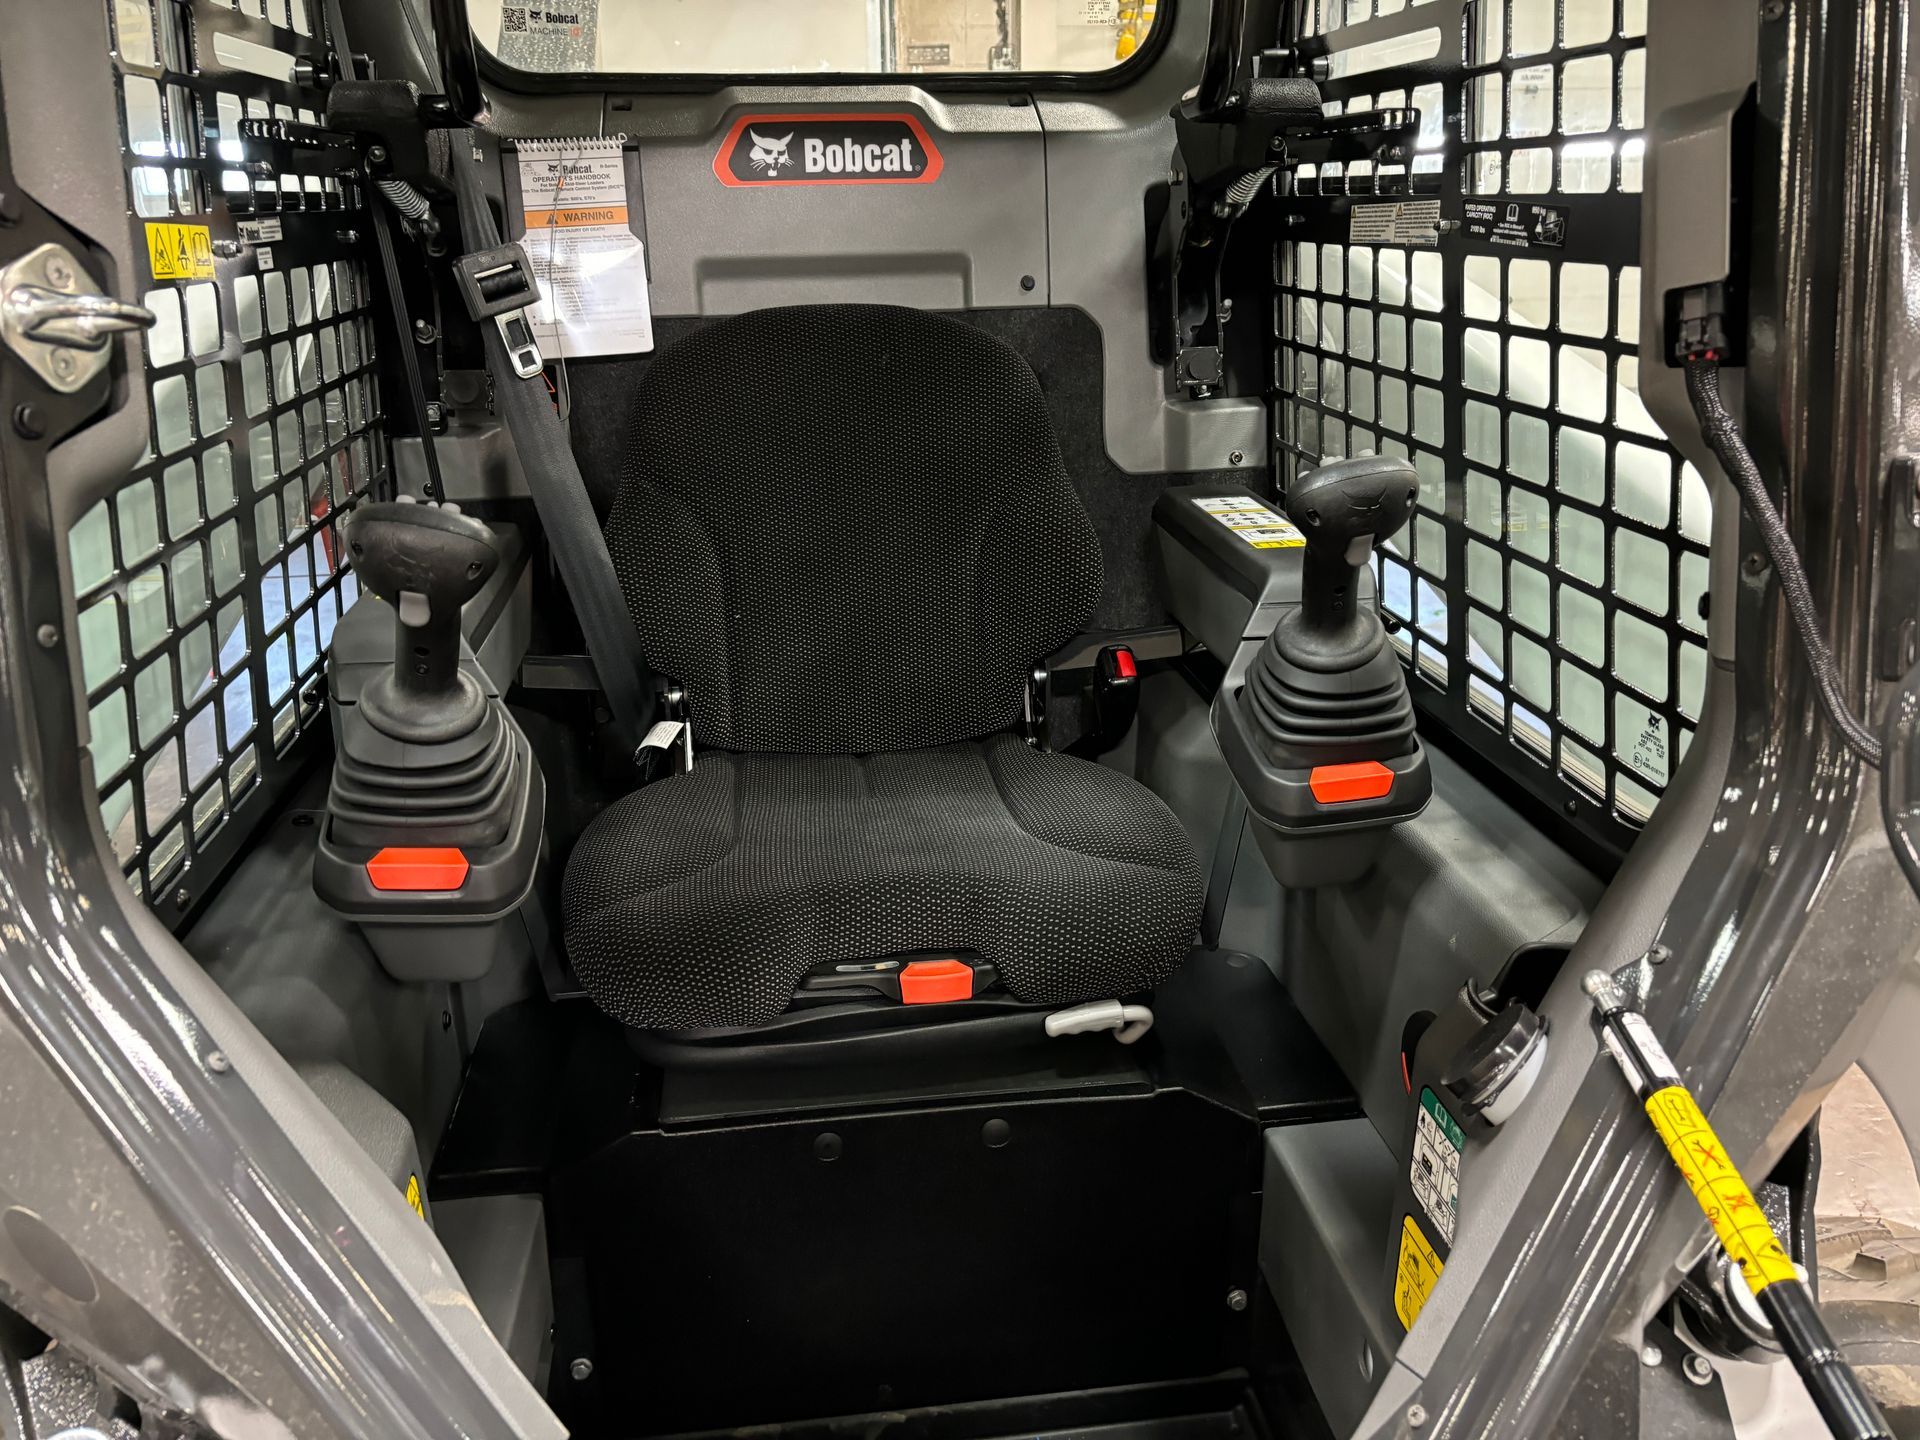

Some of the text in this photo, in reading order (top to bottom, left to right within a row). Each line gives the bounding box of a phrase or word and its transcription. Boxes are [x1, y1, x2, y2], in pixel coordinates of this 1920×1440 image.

[545, 12, 579, 24] Bobcat
[529, 27, 568, 36] MACHINE
[803, 137, 913, 173] Bobcat
[562, 164, 592, 174] Bobcat
[532, 173, 611, 183] OPERATR'S HANDBOOK
[1476, 205, 1496, 213] OPERATING
[563, 210, 614, 222] WARNING
